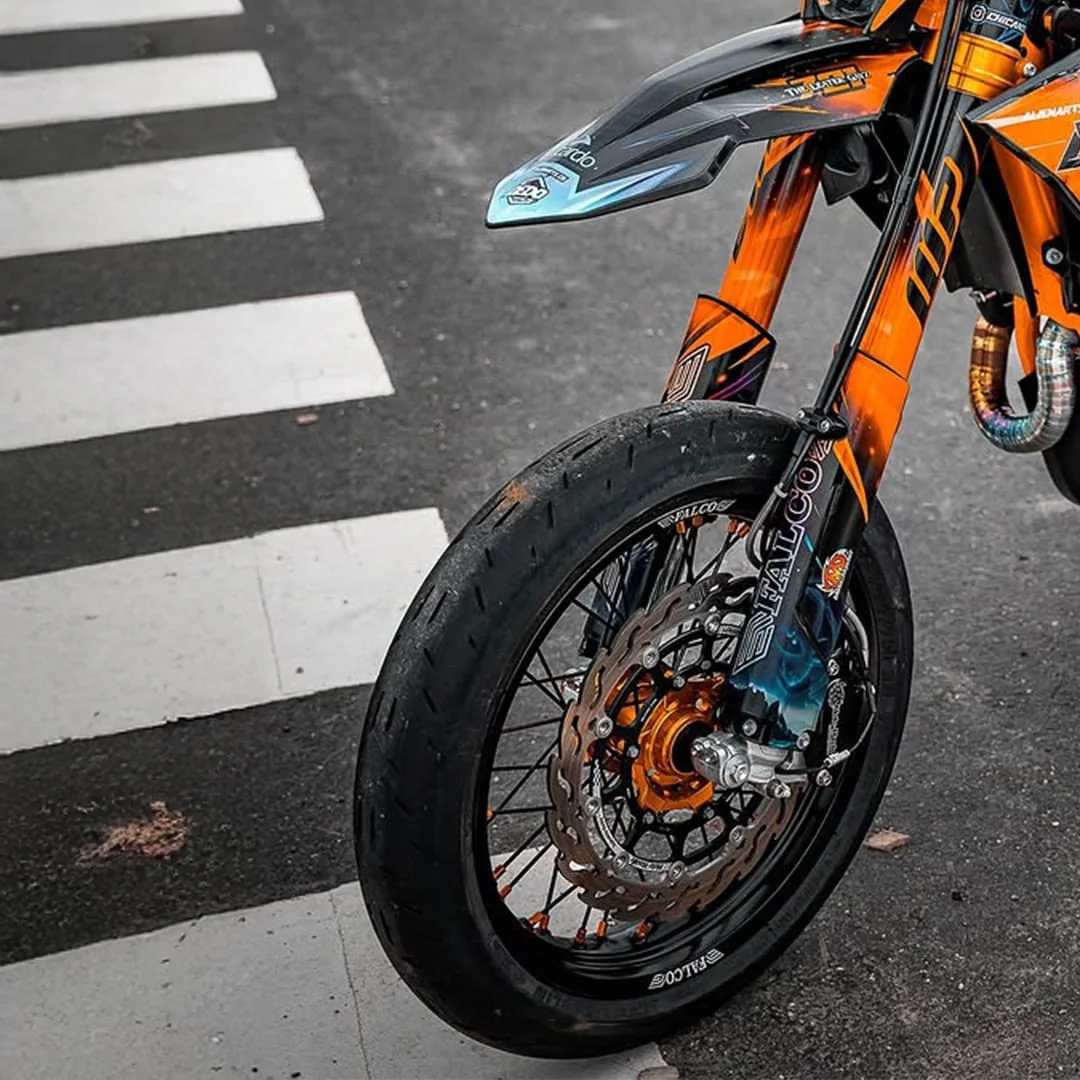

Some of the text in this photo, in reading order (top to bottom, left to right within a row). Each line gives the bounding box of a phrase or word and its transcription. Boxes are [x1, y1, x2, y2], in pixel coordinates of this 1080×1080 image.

[674, 500, 718, 522] FALCO
[754, 457, 824, 617] FALCO
[666, 956, 708, 984] FALCO
